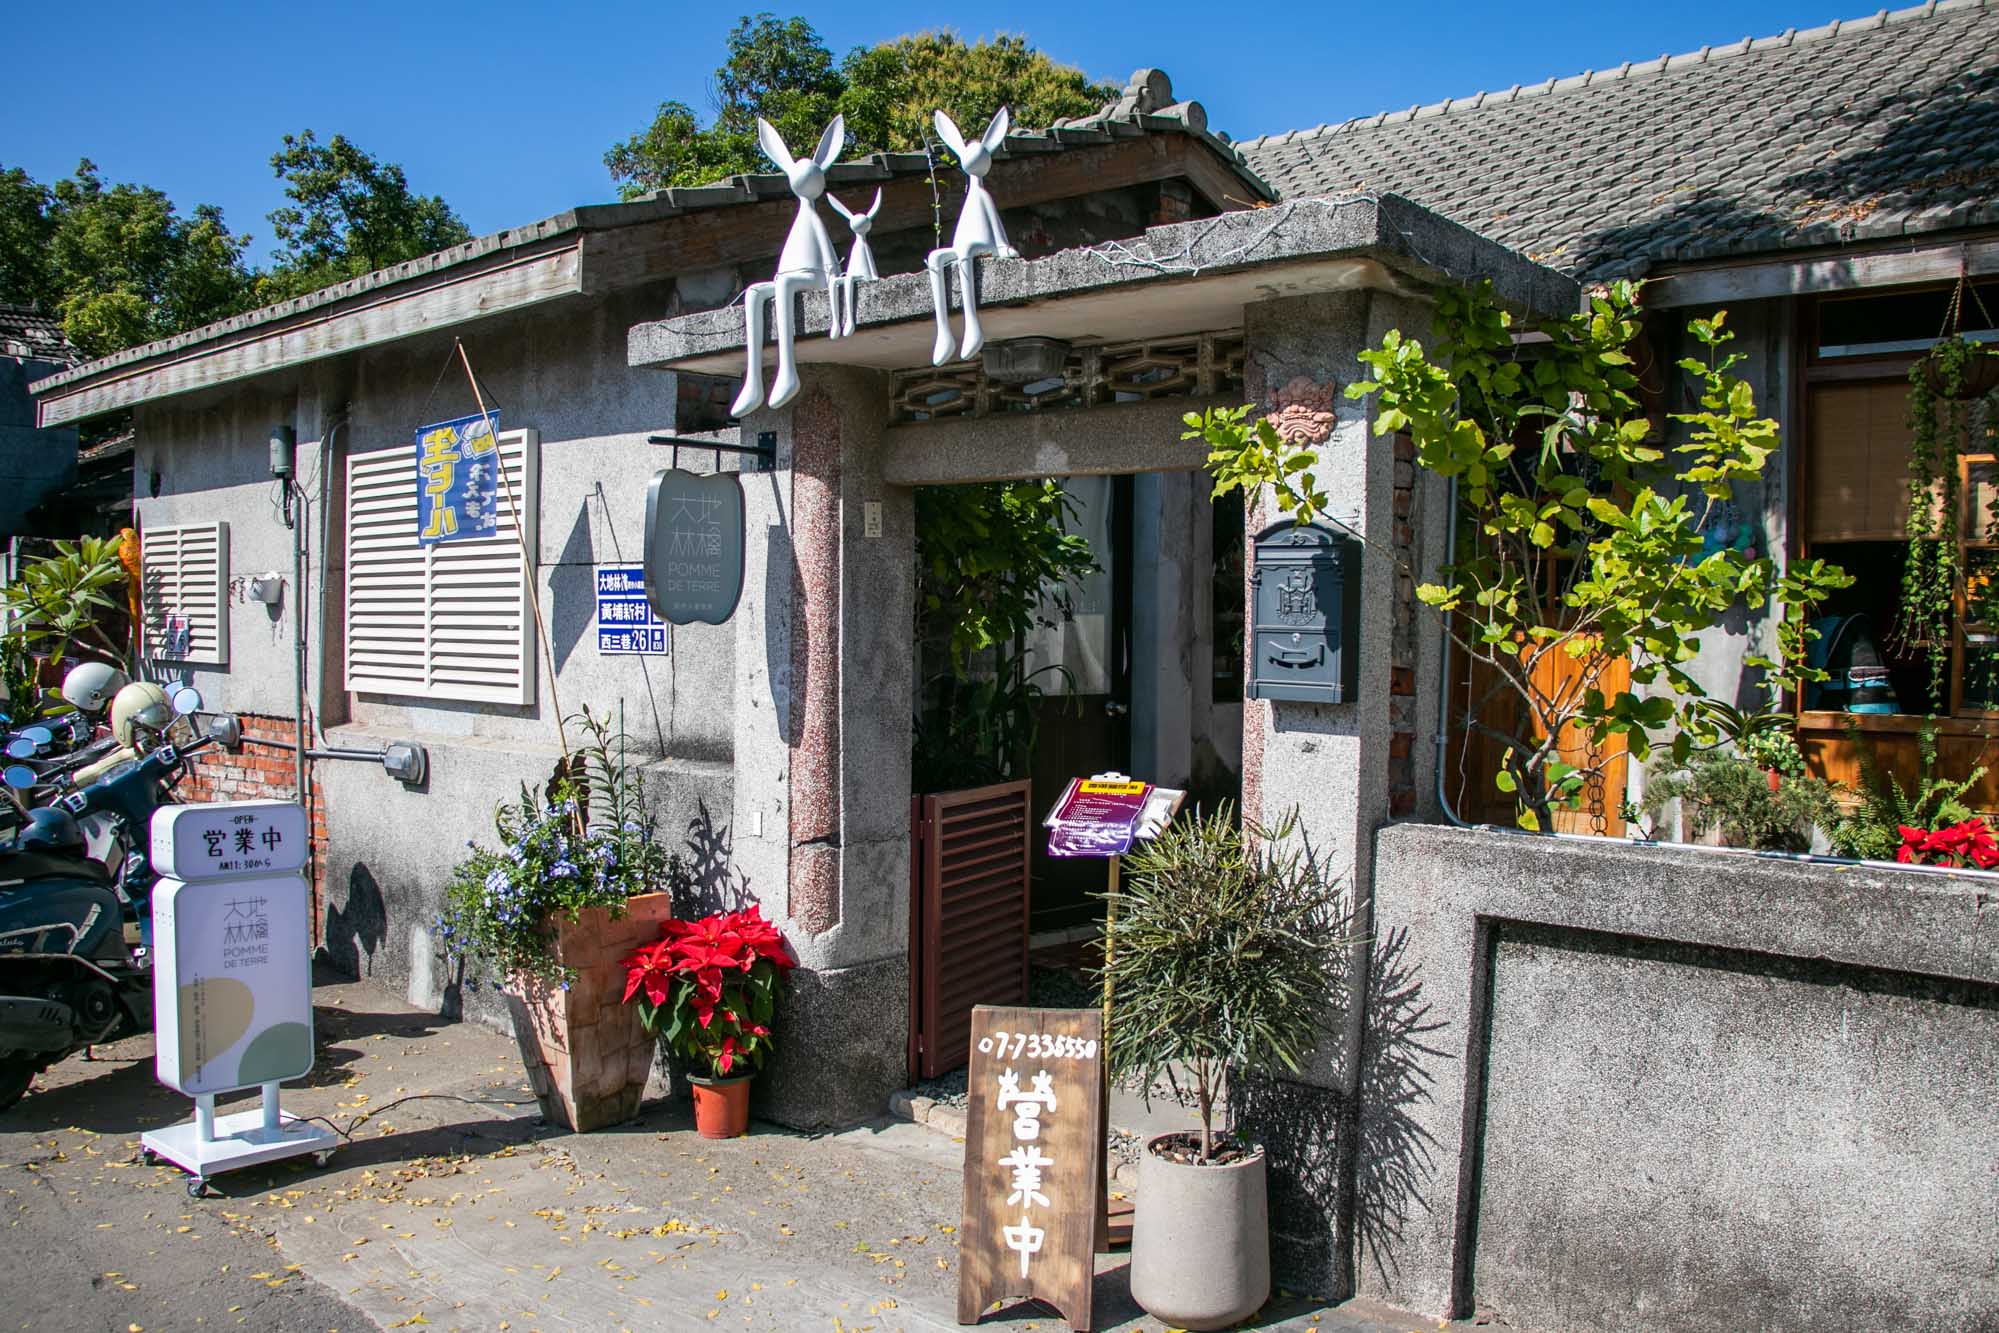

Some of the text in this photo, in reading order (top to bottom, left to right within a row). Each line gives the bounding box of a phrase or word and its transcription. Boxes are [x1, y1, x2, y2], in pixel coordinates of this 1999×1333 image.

[667, 560, 721, 577] POMME
[667, 580, 721, 593] DE TERRE
[601, 603, 646, 621] 黃埔新村
[203, 826, 282, 857] 営業中
[224, 943, 269, 958] POMME
[224, 954, 269, 969] DE TERRE
[997, 1067, 1057, 1279] 營業中
